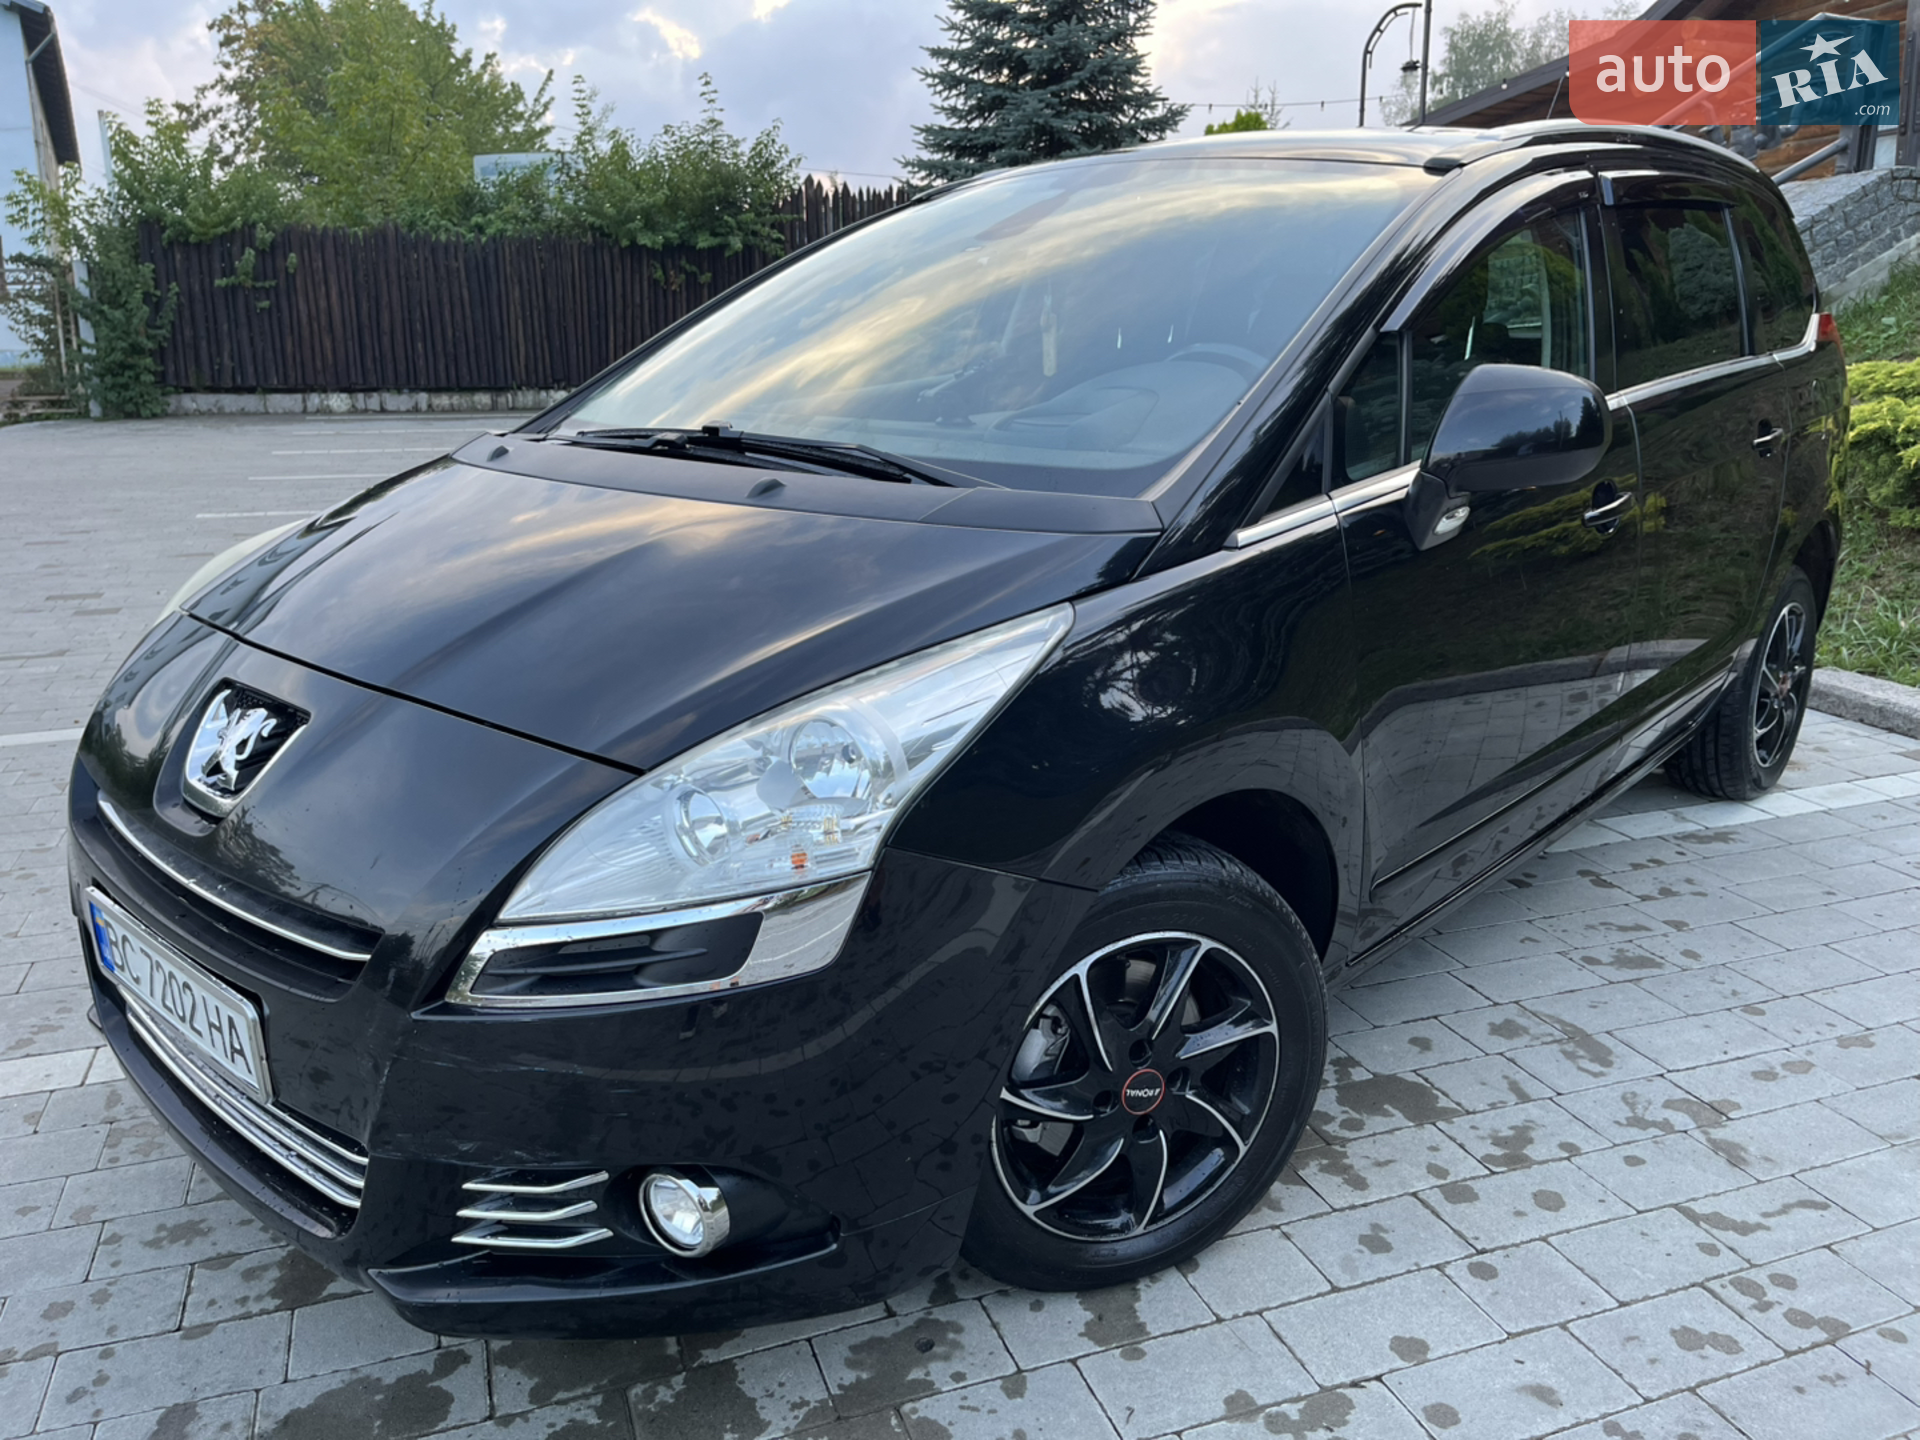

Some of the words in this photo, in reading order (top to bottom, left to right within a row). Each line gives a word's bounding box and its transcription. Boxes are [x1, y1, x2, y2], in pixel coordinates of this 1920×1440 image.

[106, 919, 140, 986] BC
[139, 946, 204, 1039] 7202
[202, 994, 253, 1075] HA
